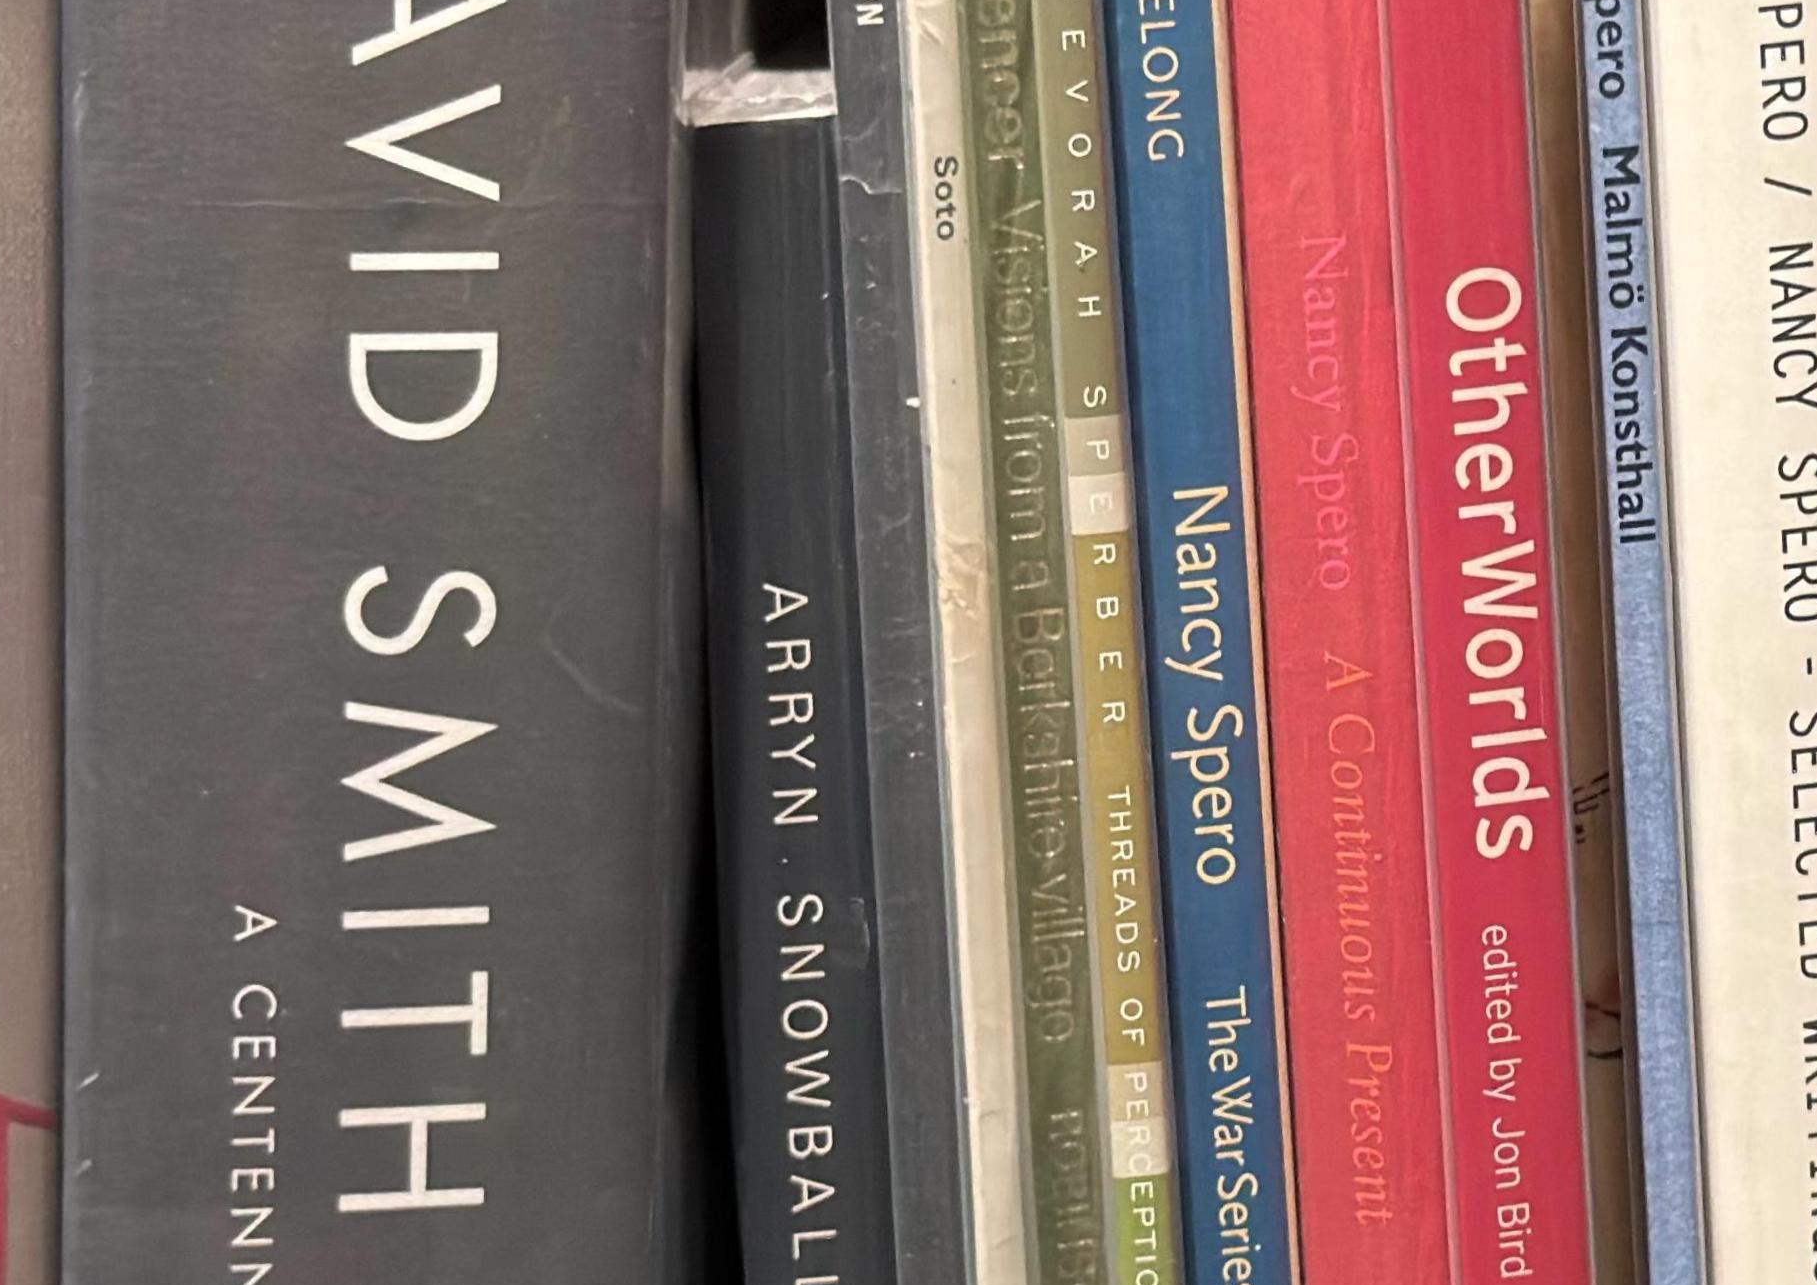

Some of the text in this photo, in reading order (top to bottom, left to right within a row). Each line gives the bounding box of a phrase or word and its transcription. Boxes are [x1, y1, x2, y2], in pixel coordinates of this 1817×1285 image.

[934, 155, 959, 240] Soto
[1602, 142, 1656, 543] Malmö Konsthall
[762, 583, 821, 823] ARRYN
[1083, 385, 1126, 722] SPERBER
[1164, 485, 1244, 885] Nancy Spero
[339, 563, 499, 1212] SMITH
[1107, 785, 1141, 973] THREADS
[1204, 985, 1247, 1070] The
[1326, 713, 1394, 1227] Continuous Present
[1209, 1075, 1254, 1165] War
[1484, 923, 1533, 1280] edited by Jon Bird
